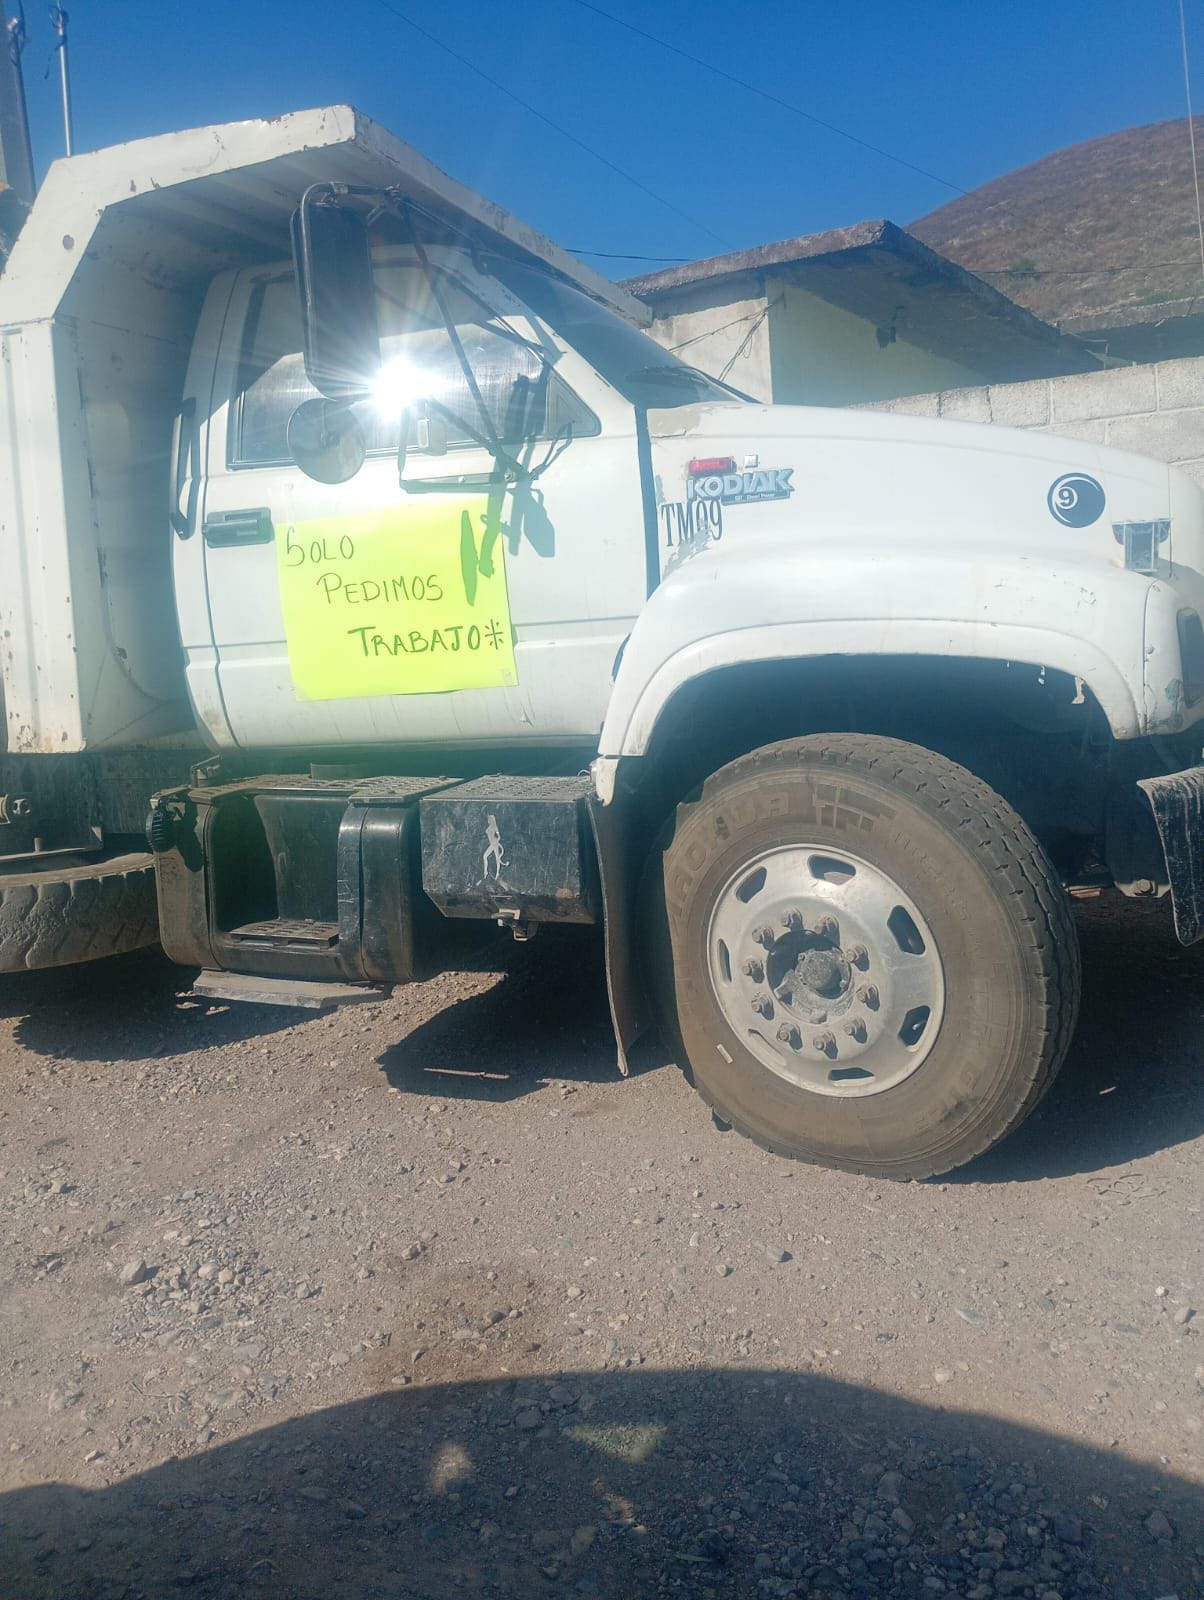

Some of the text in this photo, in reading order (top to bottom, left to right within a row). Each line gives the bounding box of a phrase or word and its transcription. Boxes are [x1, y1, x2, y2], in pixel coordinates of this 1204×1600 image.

[687, 469, 795, 500] KODIAK
[1058, 488, 1074, 506] 9
[661, 499, 722, 546] TM09
[286, 525, 355, 567] SOLO
[315, 572, 444, 605] PEDIMOS
[347, 624, 482, 657] TRABAJO
